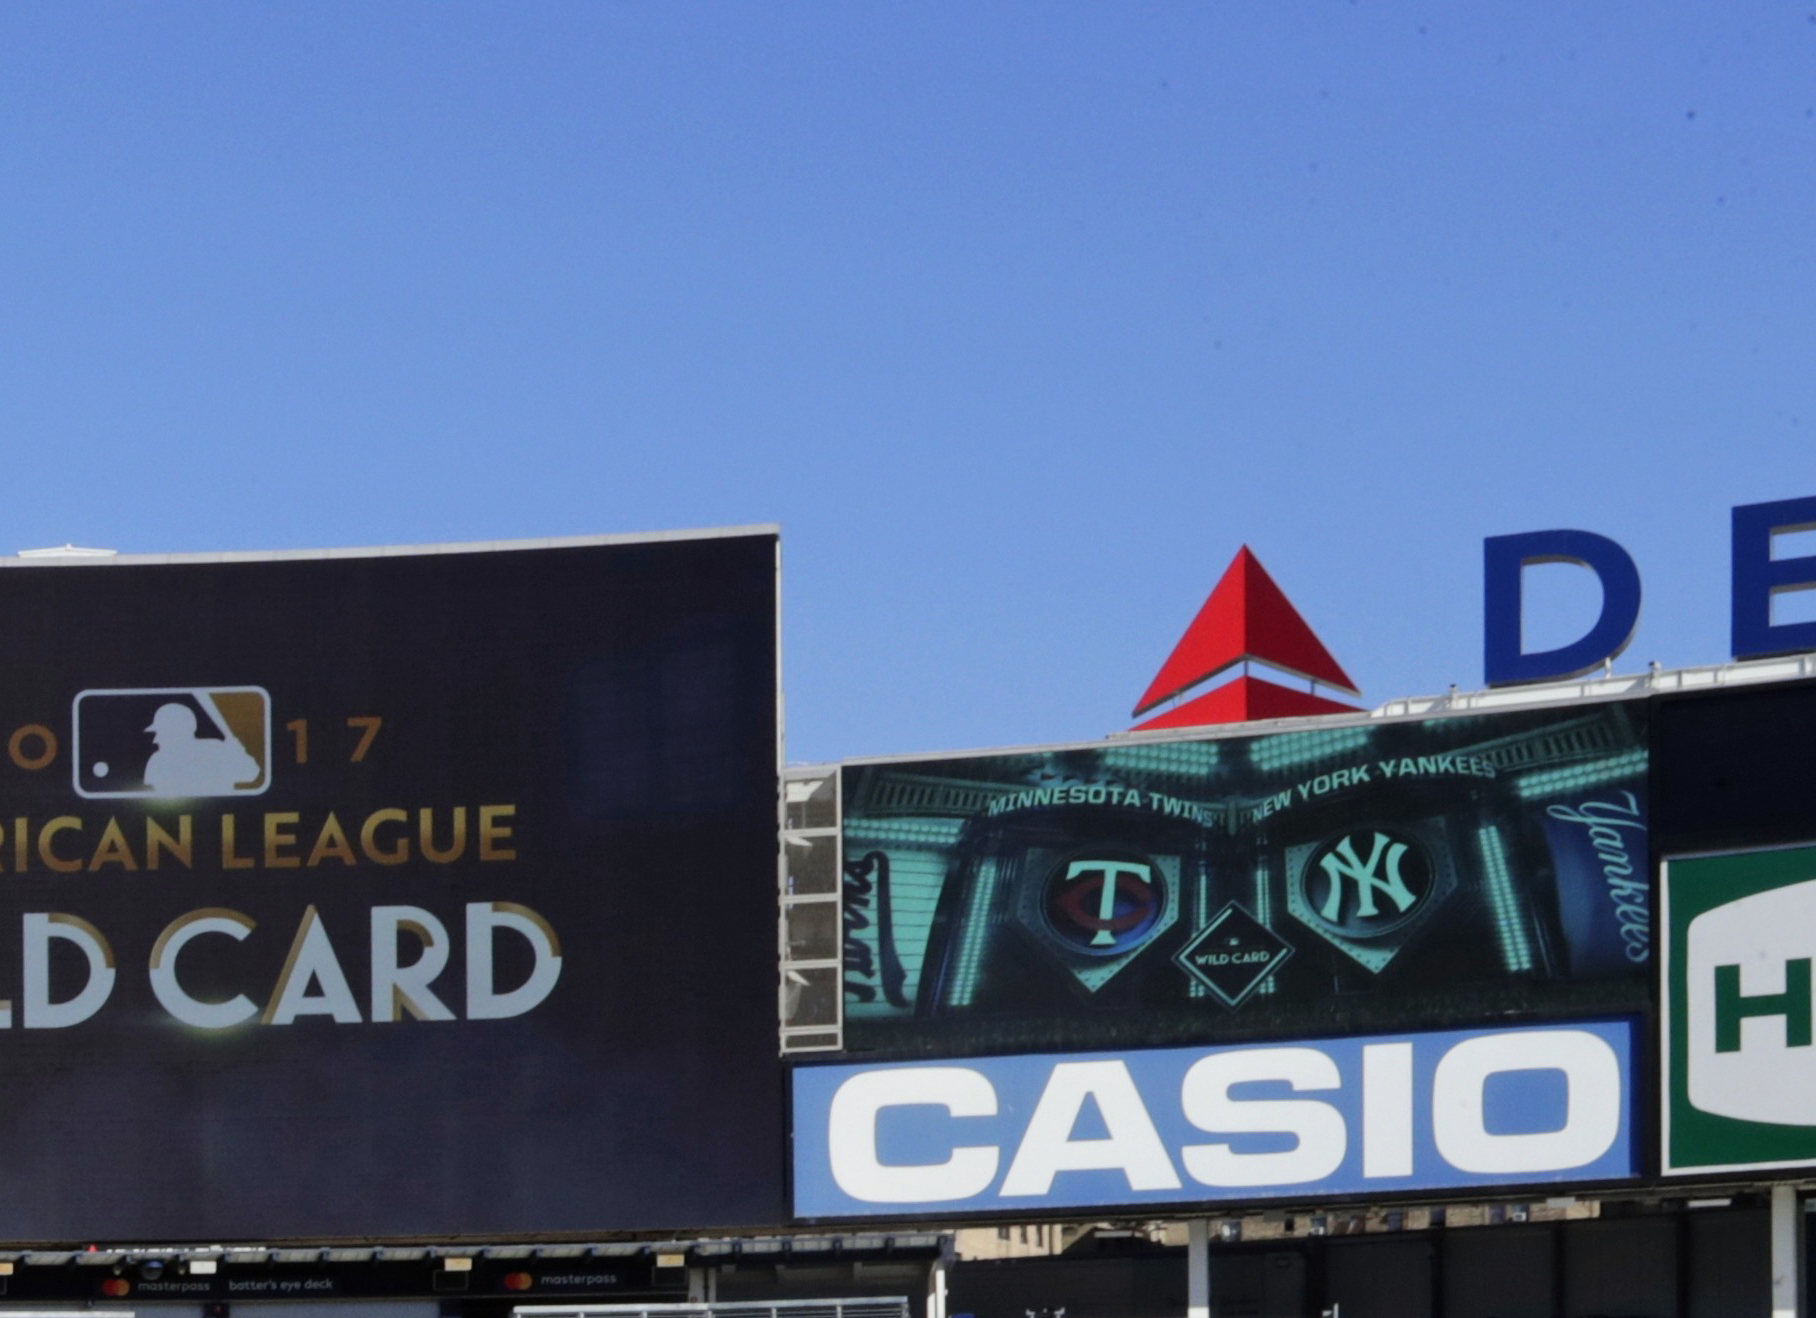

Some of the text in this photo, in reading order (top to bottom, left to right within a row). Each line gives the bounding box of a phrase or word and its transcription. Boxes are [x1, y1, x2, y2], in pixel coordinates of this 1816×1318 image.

[988, 785, 1214, 827] MINNESOTA TWINS
[1252, 755, 1497, 824] NEW YORK YANKEES
[221, 804, 517, 870] LEAGUE
[149, 900, 562, 1031] CARD
[1195, 949, 1270, 967] WILD CARD
[828, 1029, 1621, 1203] CASIO
[138, 1278, 333, 1292] masterpass batter's eye deck
[541, 1273, 617, 1286] masterpass
